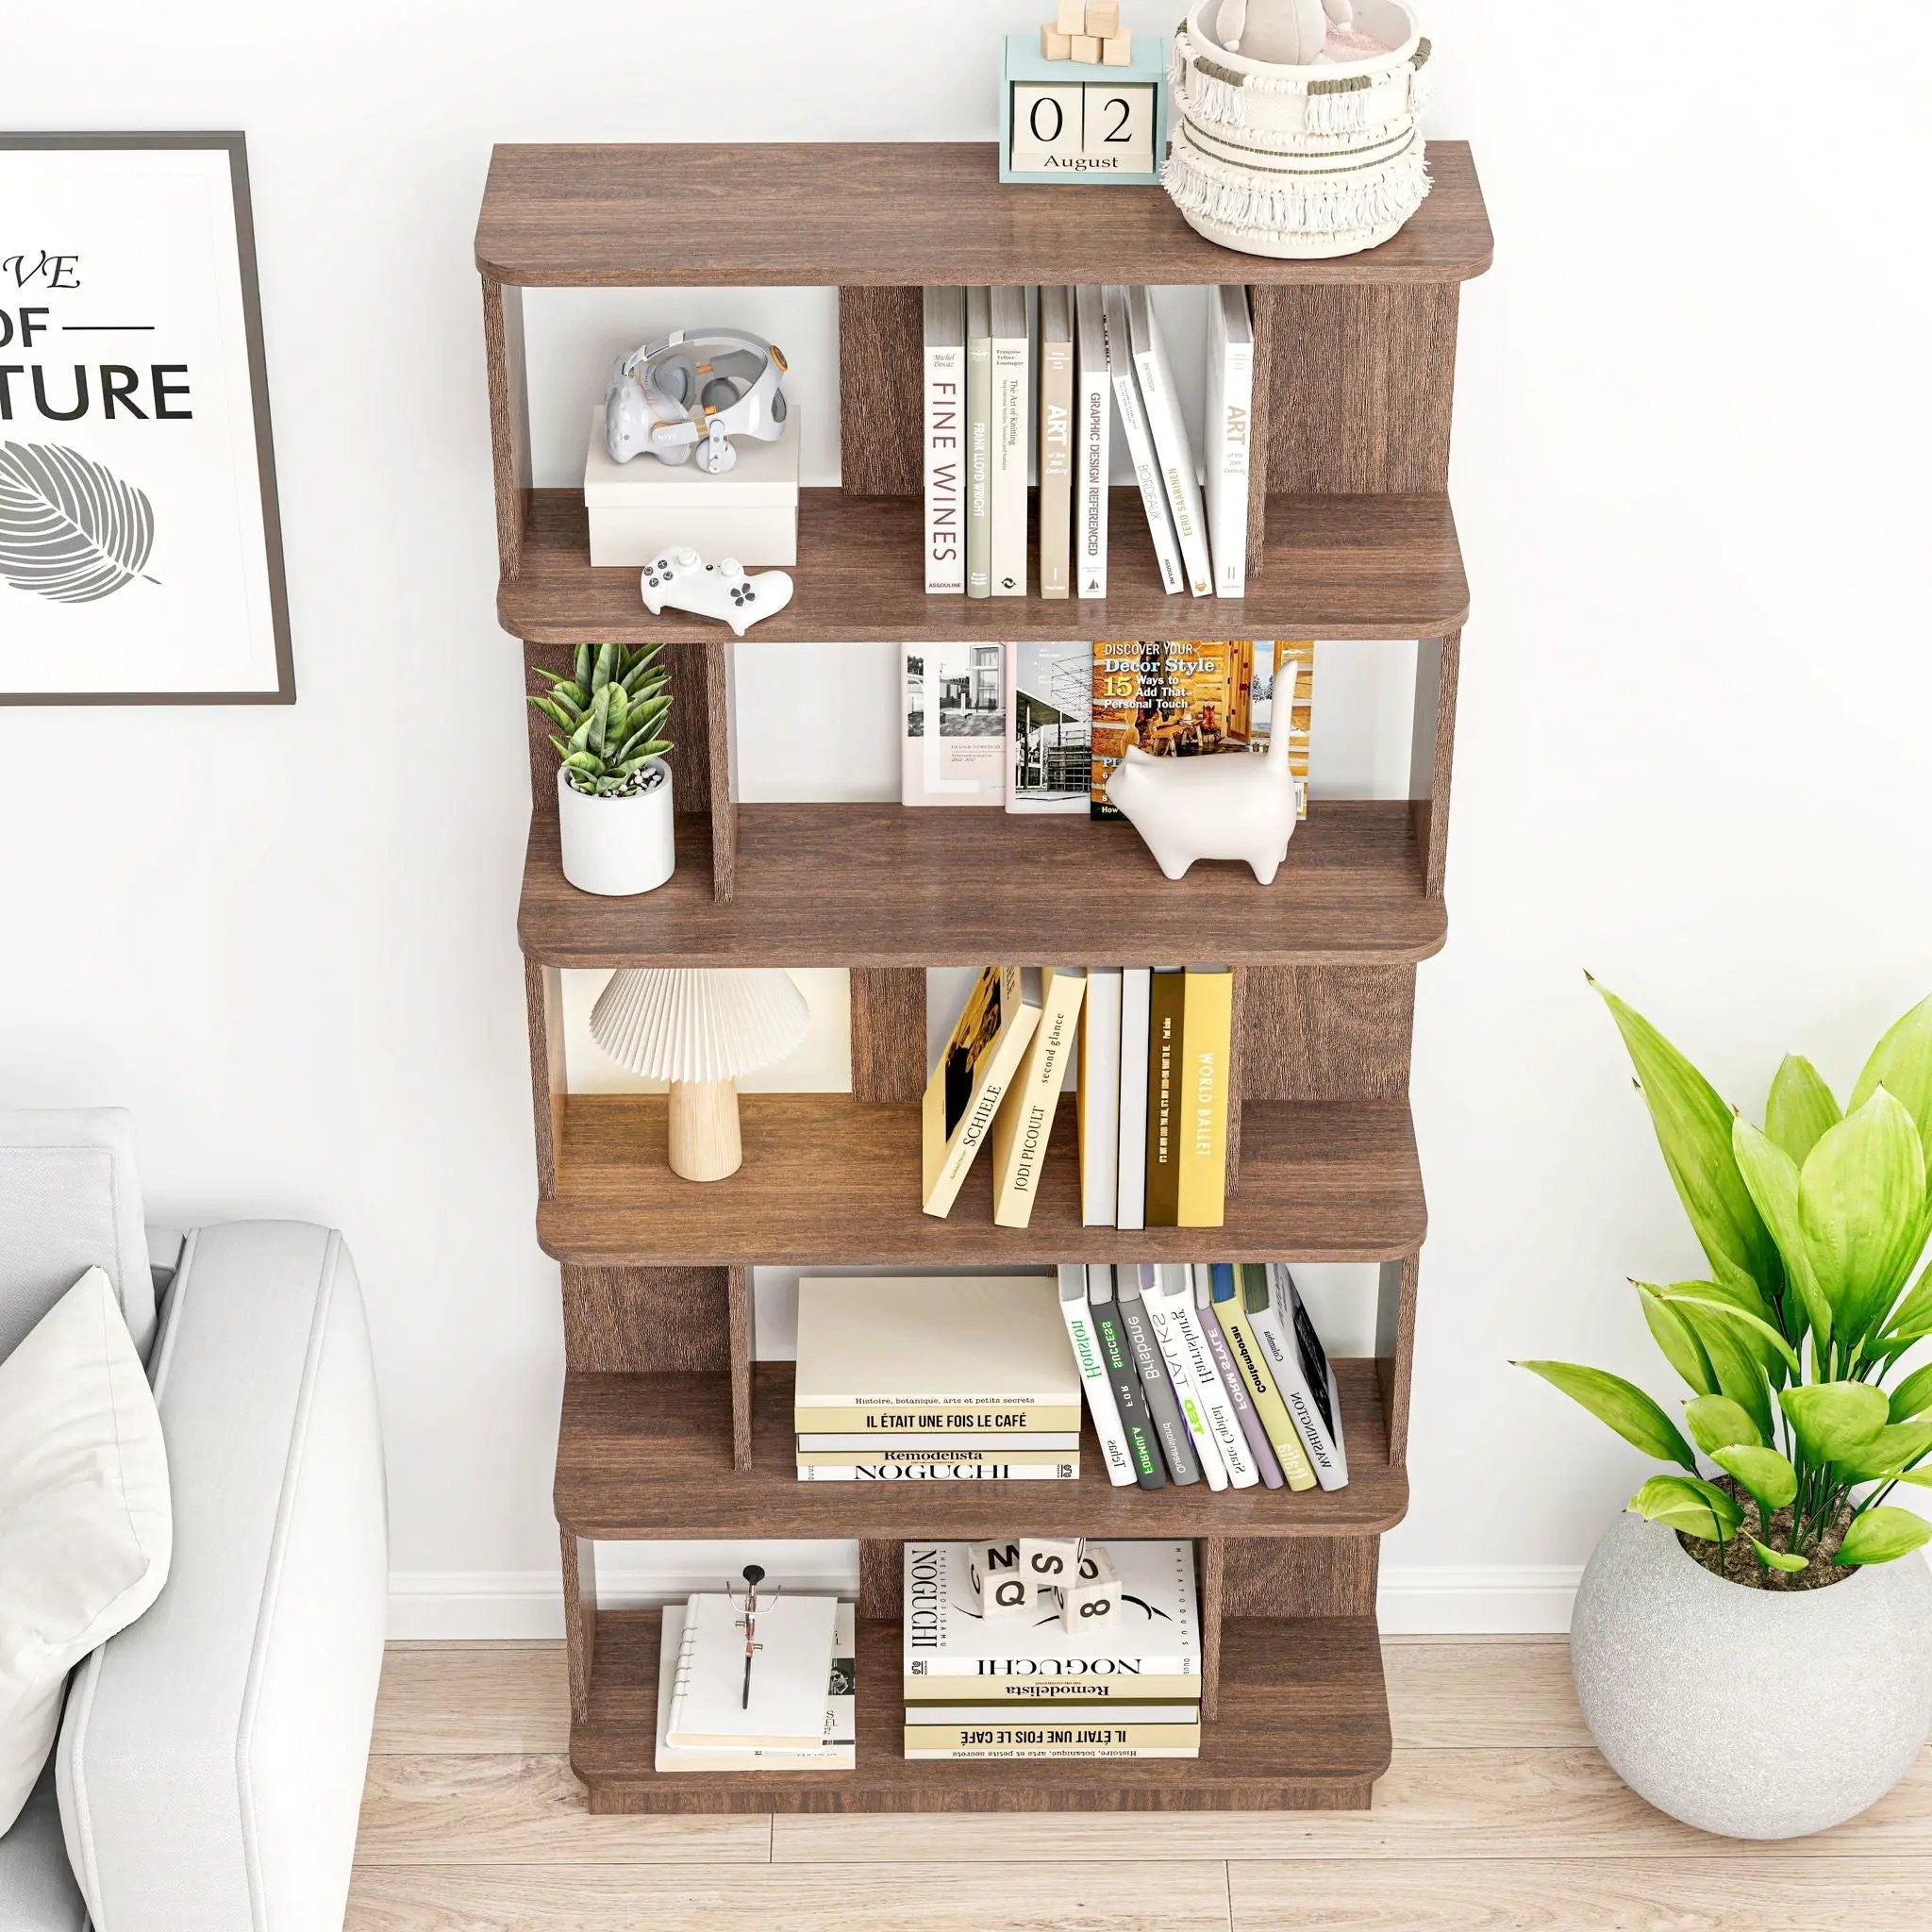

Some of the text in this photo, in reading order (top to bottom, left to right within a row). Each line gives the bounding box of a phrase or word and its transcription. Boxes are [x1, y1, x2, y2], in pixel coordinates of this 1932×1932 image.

[1043, 155, 1119, 171] August
[1047, 404, 1067, 445] ART
[1091, 392, 1101, 441] GRAPHIC
[1227, 405, 1246, 445] ART
[1008, 417, 1018, 445] Knitting
[933, 383, 957, 560] FINE WINES
[974, 423, 985, 517] FRANK LLOYD WRIGHT
[1090, 444, 1100, 483] DESIGN
[1138, 464, 1161, 521] BORDEAUX
[1168, 467, 1192, 537] EERO SAARINEN
[1088, 487, 1099, 556] REFERENCED
[1164, 558, 1175, 585] ASSOULINE
[1105, 644, 1193, 656] DISCOVER YOUR
[1104, 658, 1215, 675] Decor Style
[1104, 676, 1133, 697] 15
[1136, 675, 1178, 686] Ways to
[1136, 688, 1186, 697] Add That
[1104, 700, 1188, 708] Personal Touch
[1041, 1013, 1064, 1084] second glance
[963, 1085, 1002, 1147] SCHIELE
[1196, 1053, 1215, 1158] WORLD BALLET
[1013, 1106, 1045, 1191] JODI PICOULT
[867, 1412, 1026, 1427] IL ÉTAIT UNE FOIS LE CAFÉ
[884, 1451, 983, 1460] Remodelista
[854, 1464, 1009, 1480] NOGUCHI
[1031, 1553, 1063, 1574] S
[911, 1549, 938, 1648] NOGUCHI
[995, 1580, 1025, 1607] Q
[1080, 1599, 1110, 1618] 8
[976, 1658, 1142, 1675] NOGUCHI
[1006, 1686, 1109, 1697] Remodelista
[960, 1730, 1126, 1746] IL ÉTAIT UNE FOIS LE CAFÉ
